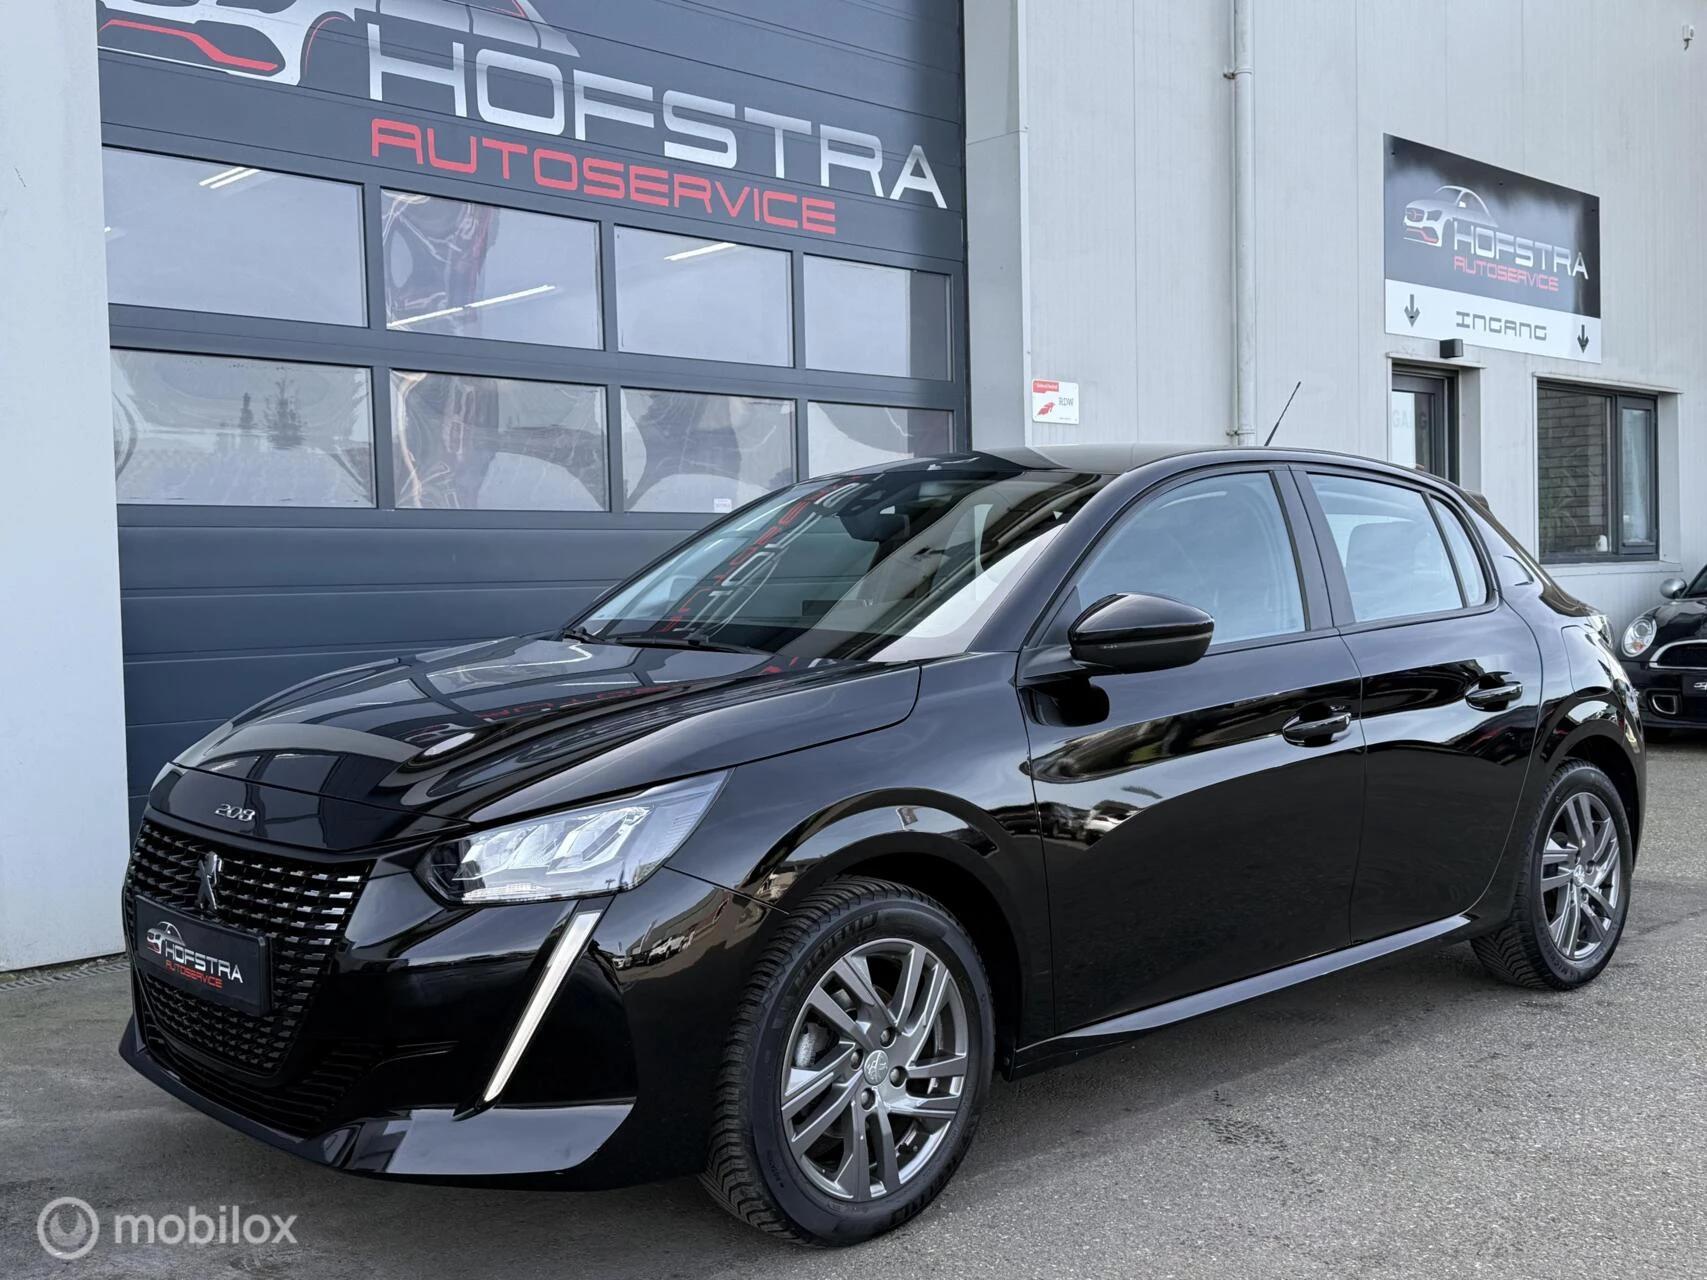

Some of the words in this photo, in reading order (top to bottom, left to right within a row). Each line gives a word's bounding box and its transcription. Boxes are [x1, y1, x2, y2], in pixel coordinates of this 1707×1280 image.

[369, 22, 948, 209] HOFSTRA
[371, 118, 837, 235] AUTOSERVICE
[1453, 220, 1589, 280] HOFSTRA
[1453, 255, 1559, 292] AUTOSERVICE
[1456, 310, 1548, 341] INGANG
[214, 803, 256, 822] 208
[165, 940, 244, 984] HOFSTRA
[165, 959, 224, 989] AUTOSERVICE
